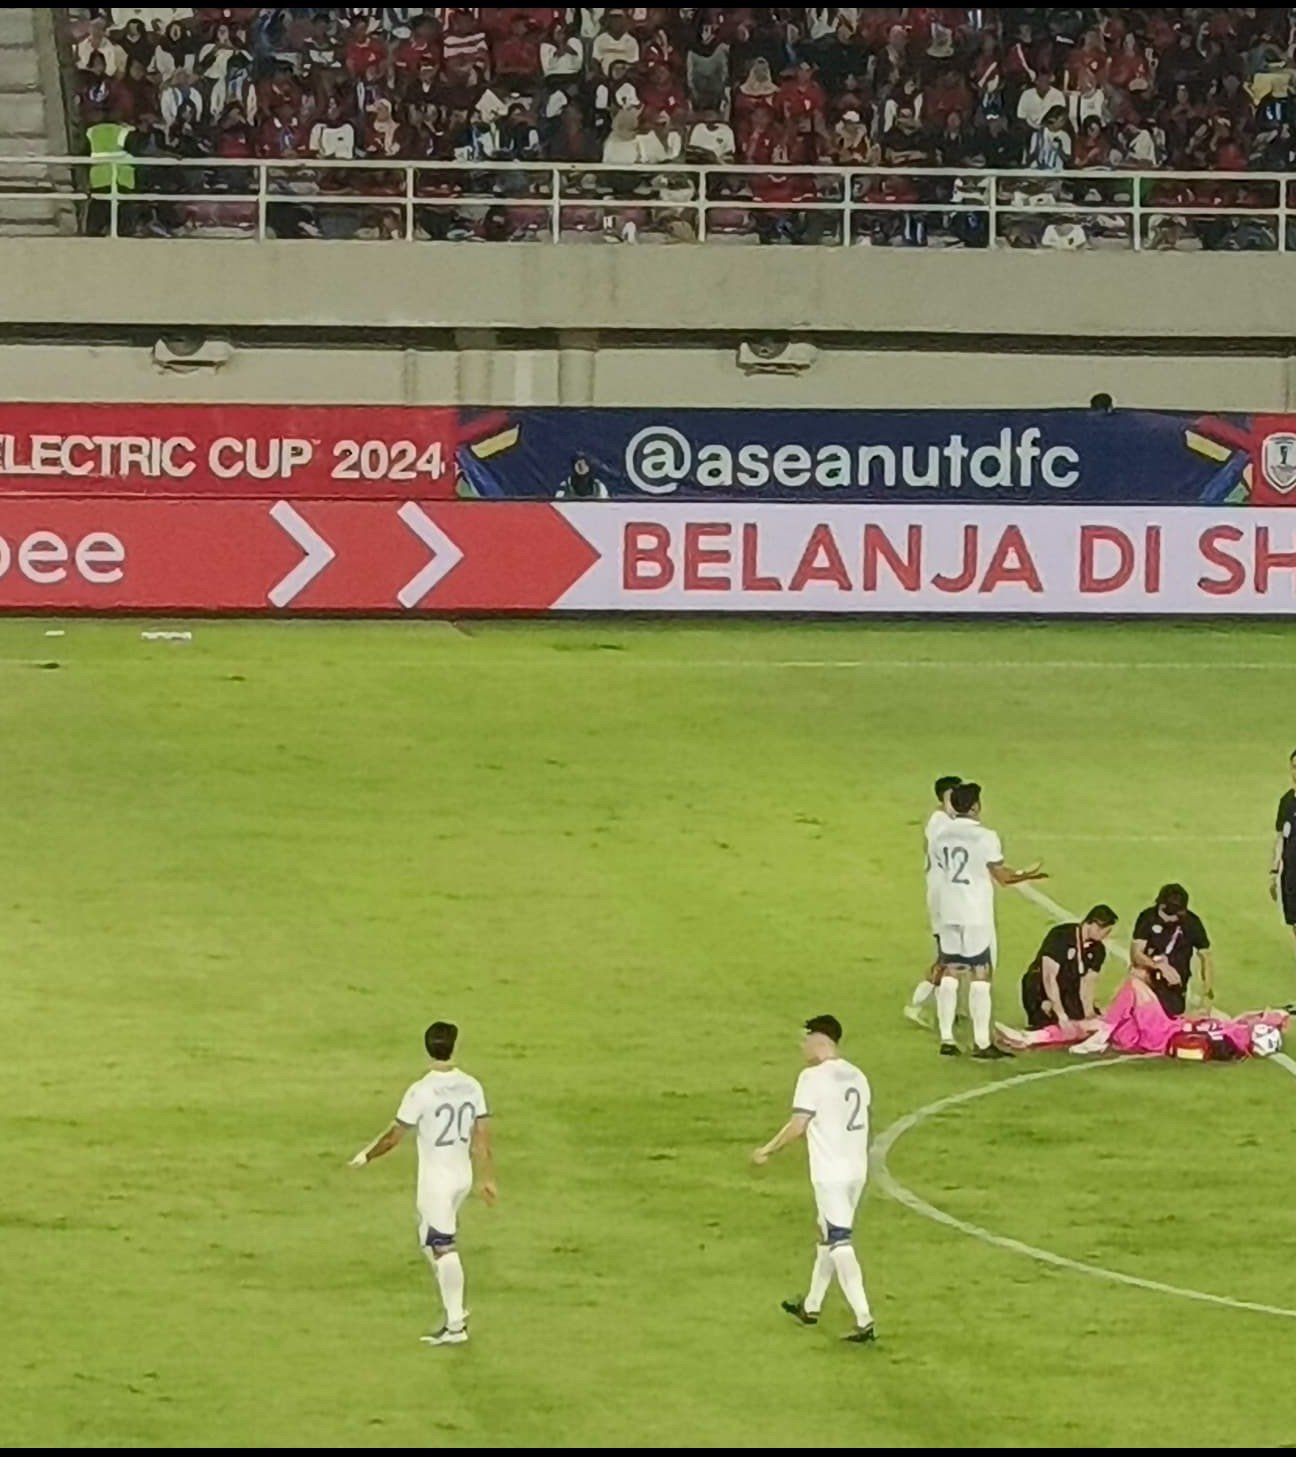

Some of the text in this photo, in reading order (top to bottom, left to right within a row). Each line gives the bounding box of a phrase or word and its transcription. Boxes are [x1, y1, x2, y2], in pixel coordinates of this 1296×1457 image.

[0, 434, 444, 480] LECTRIC CUP 2024
[625, 426, 1081, 494] @aseanutdfc
[0, 531, 125, 583] ee
[623, 522, 1044, 593] BELANJA
[1079, 525, 1162, 594] DI
[942, 846, 970, 885] 12
[435, 1101, 476, 1147] 20
[844, 1087, 864, 1131] 2
